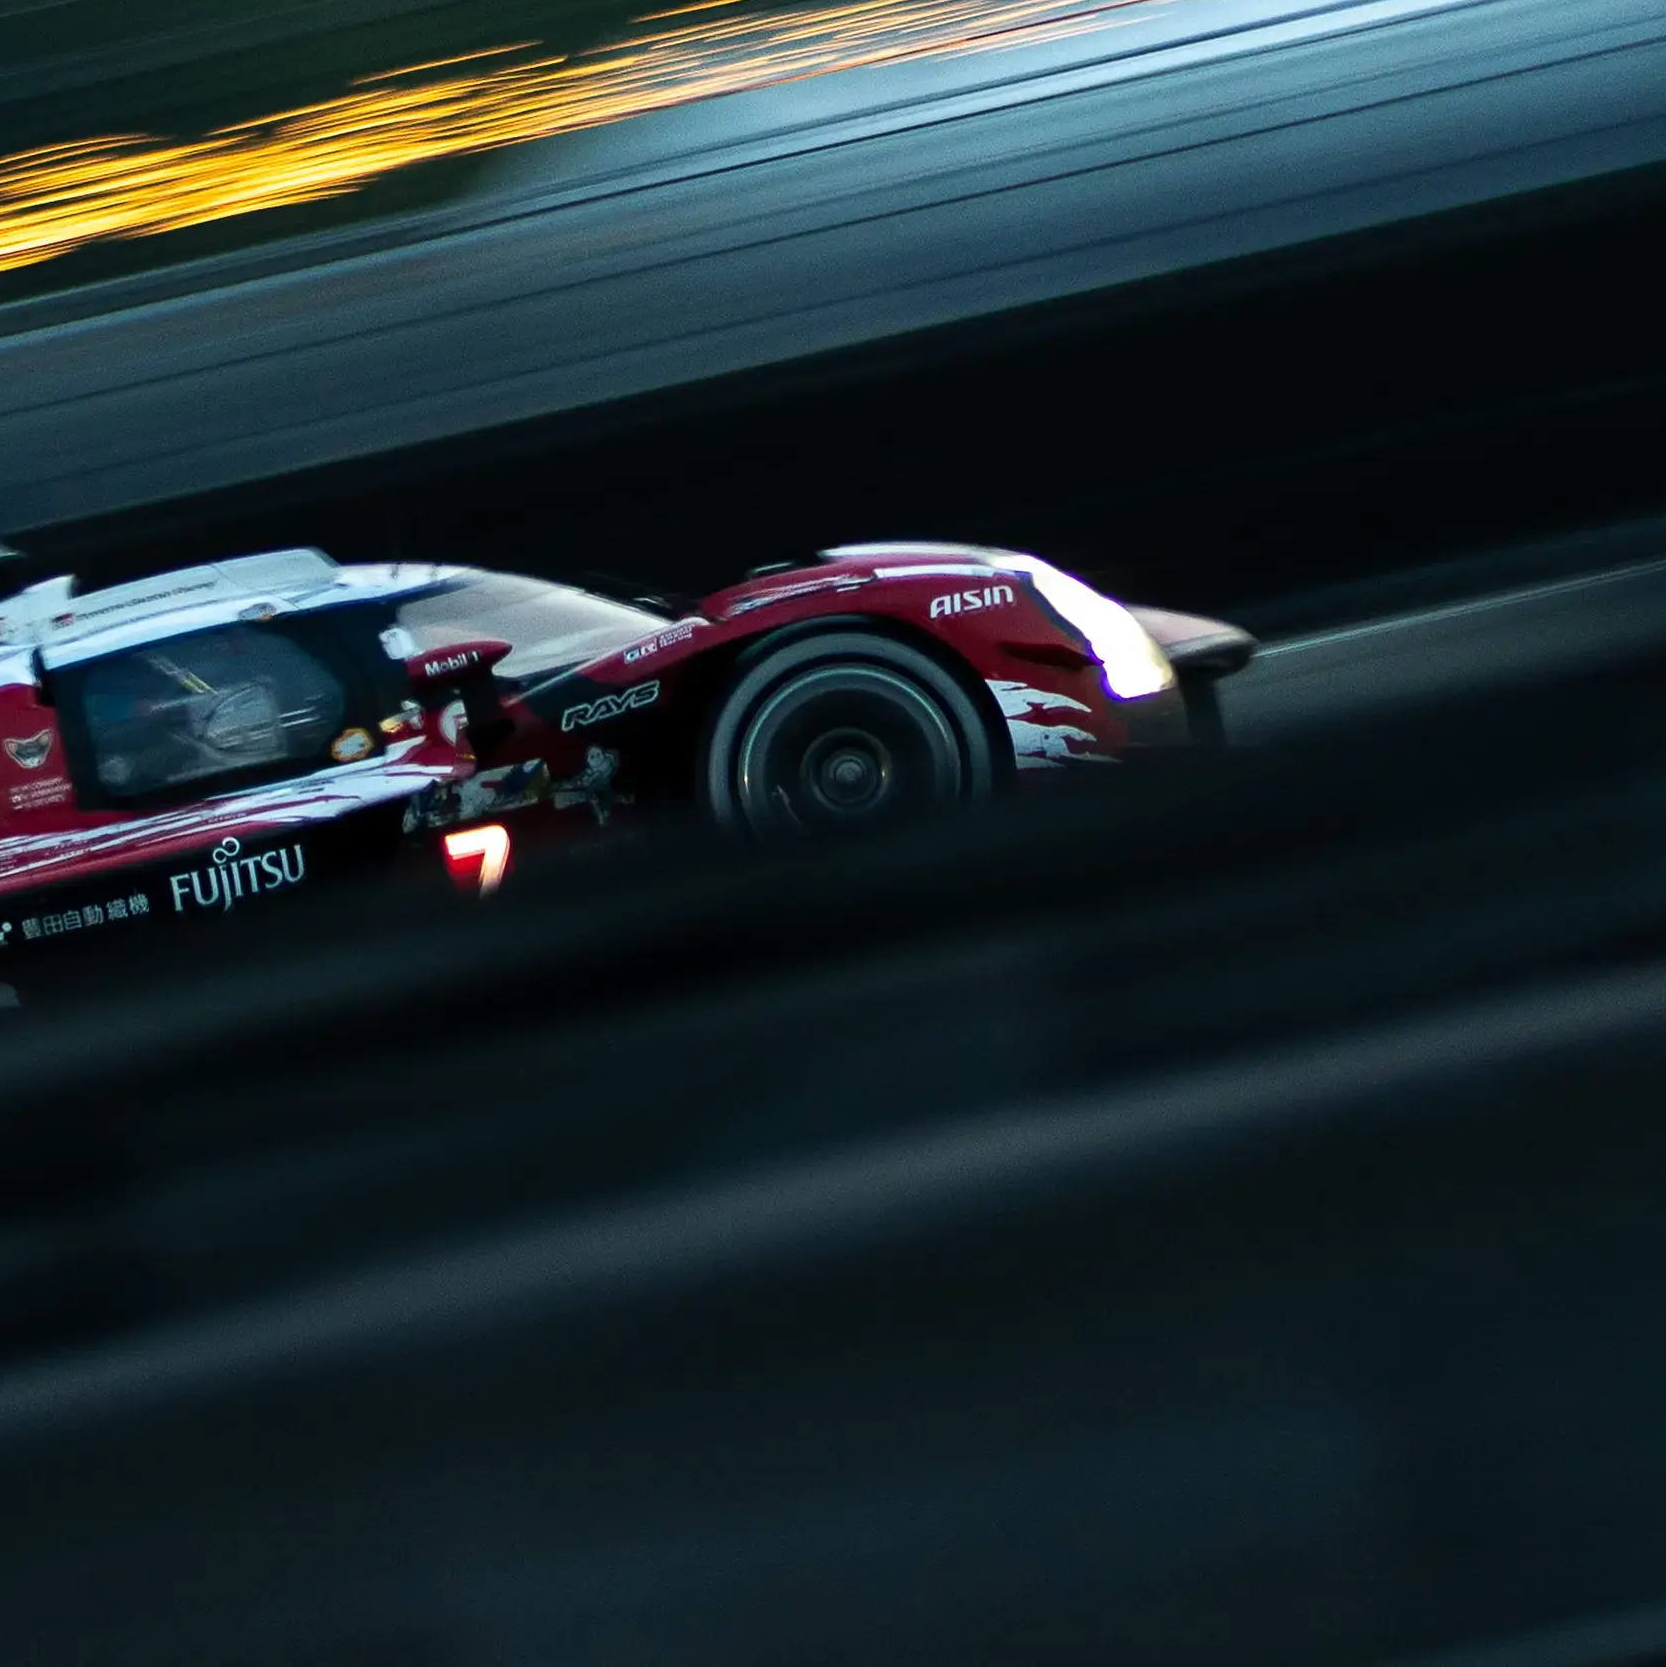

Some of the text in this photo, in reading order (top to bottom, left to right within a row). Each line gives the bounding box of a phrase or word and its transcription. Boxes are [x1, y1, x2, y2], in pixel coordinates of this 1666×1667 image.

[930, 584, 1014, 619] AISIN
[425, 650, 481, 677] Mobil 1
[561, 679, 660, 731] RAYS
[169, 836, 305, 913] FUJITSU
[445, 824, 511, 900] 7
